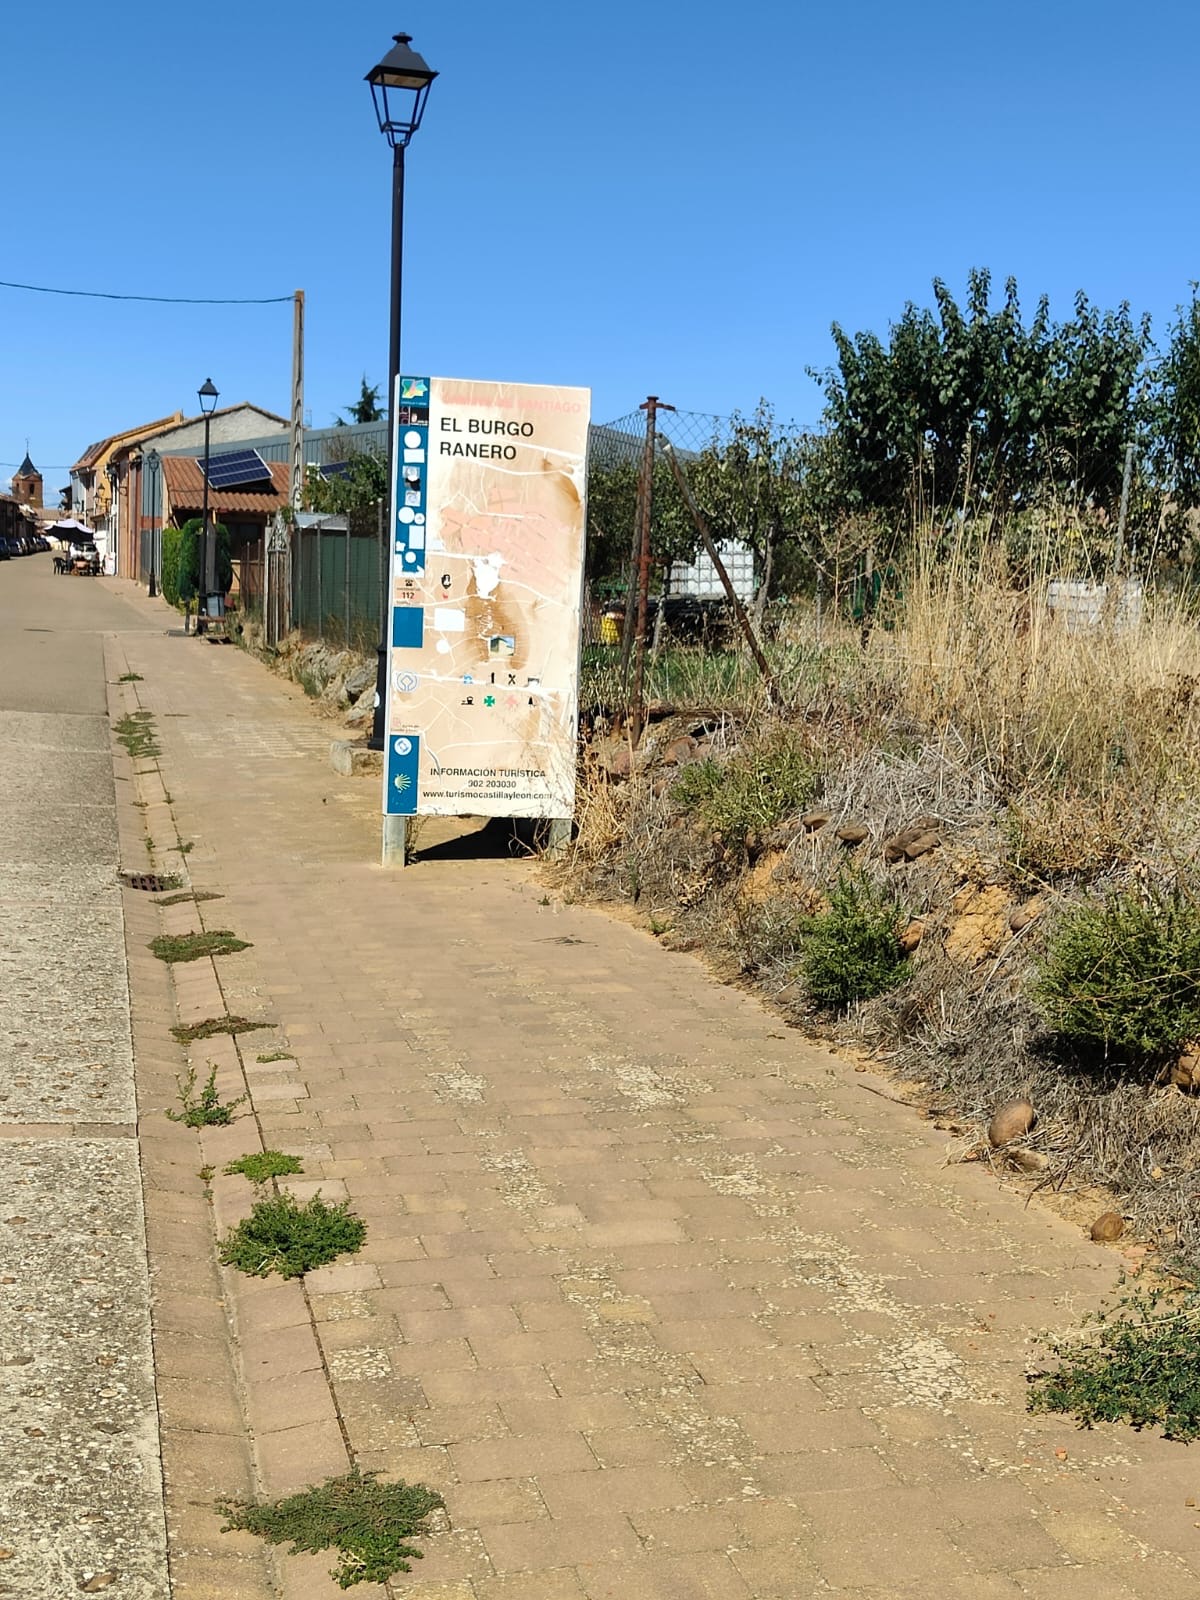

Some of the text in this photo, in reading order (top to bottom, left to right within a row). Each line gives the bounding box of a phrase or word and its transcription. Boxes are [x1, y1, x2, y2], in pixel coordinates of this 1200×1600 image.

[440, 417, 534, 437] EL BURGO
[440, 441, 517, 460] RANERO
[402, 591, 415, 600] 112
[430, 766, 546, 779] INFORMACIÓN TURÍSTICA
[486, 780, 517, 789] 203030
